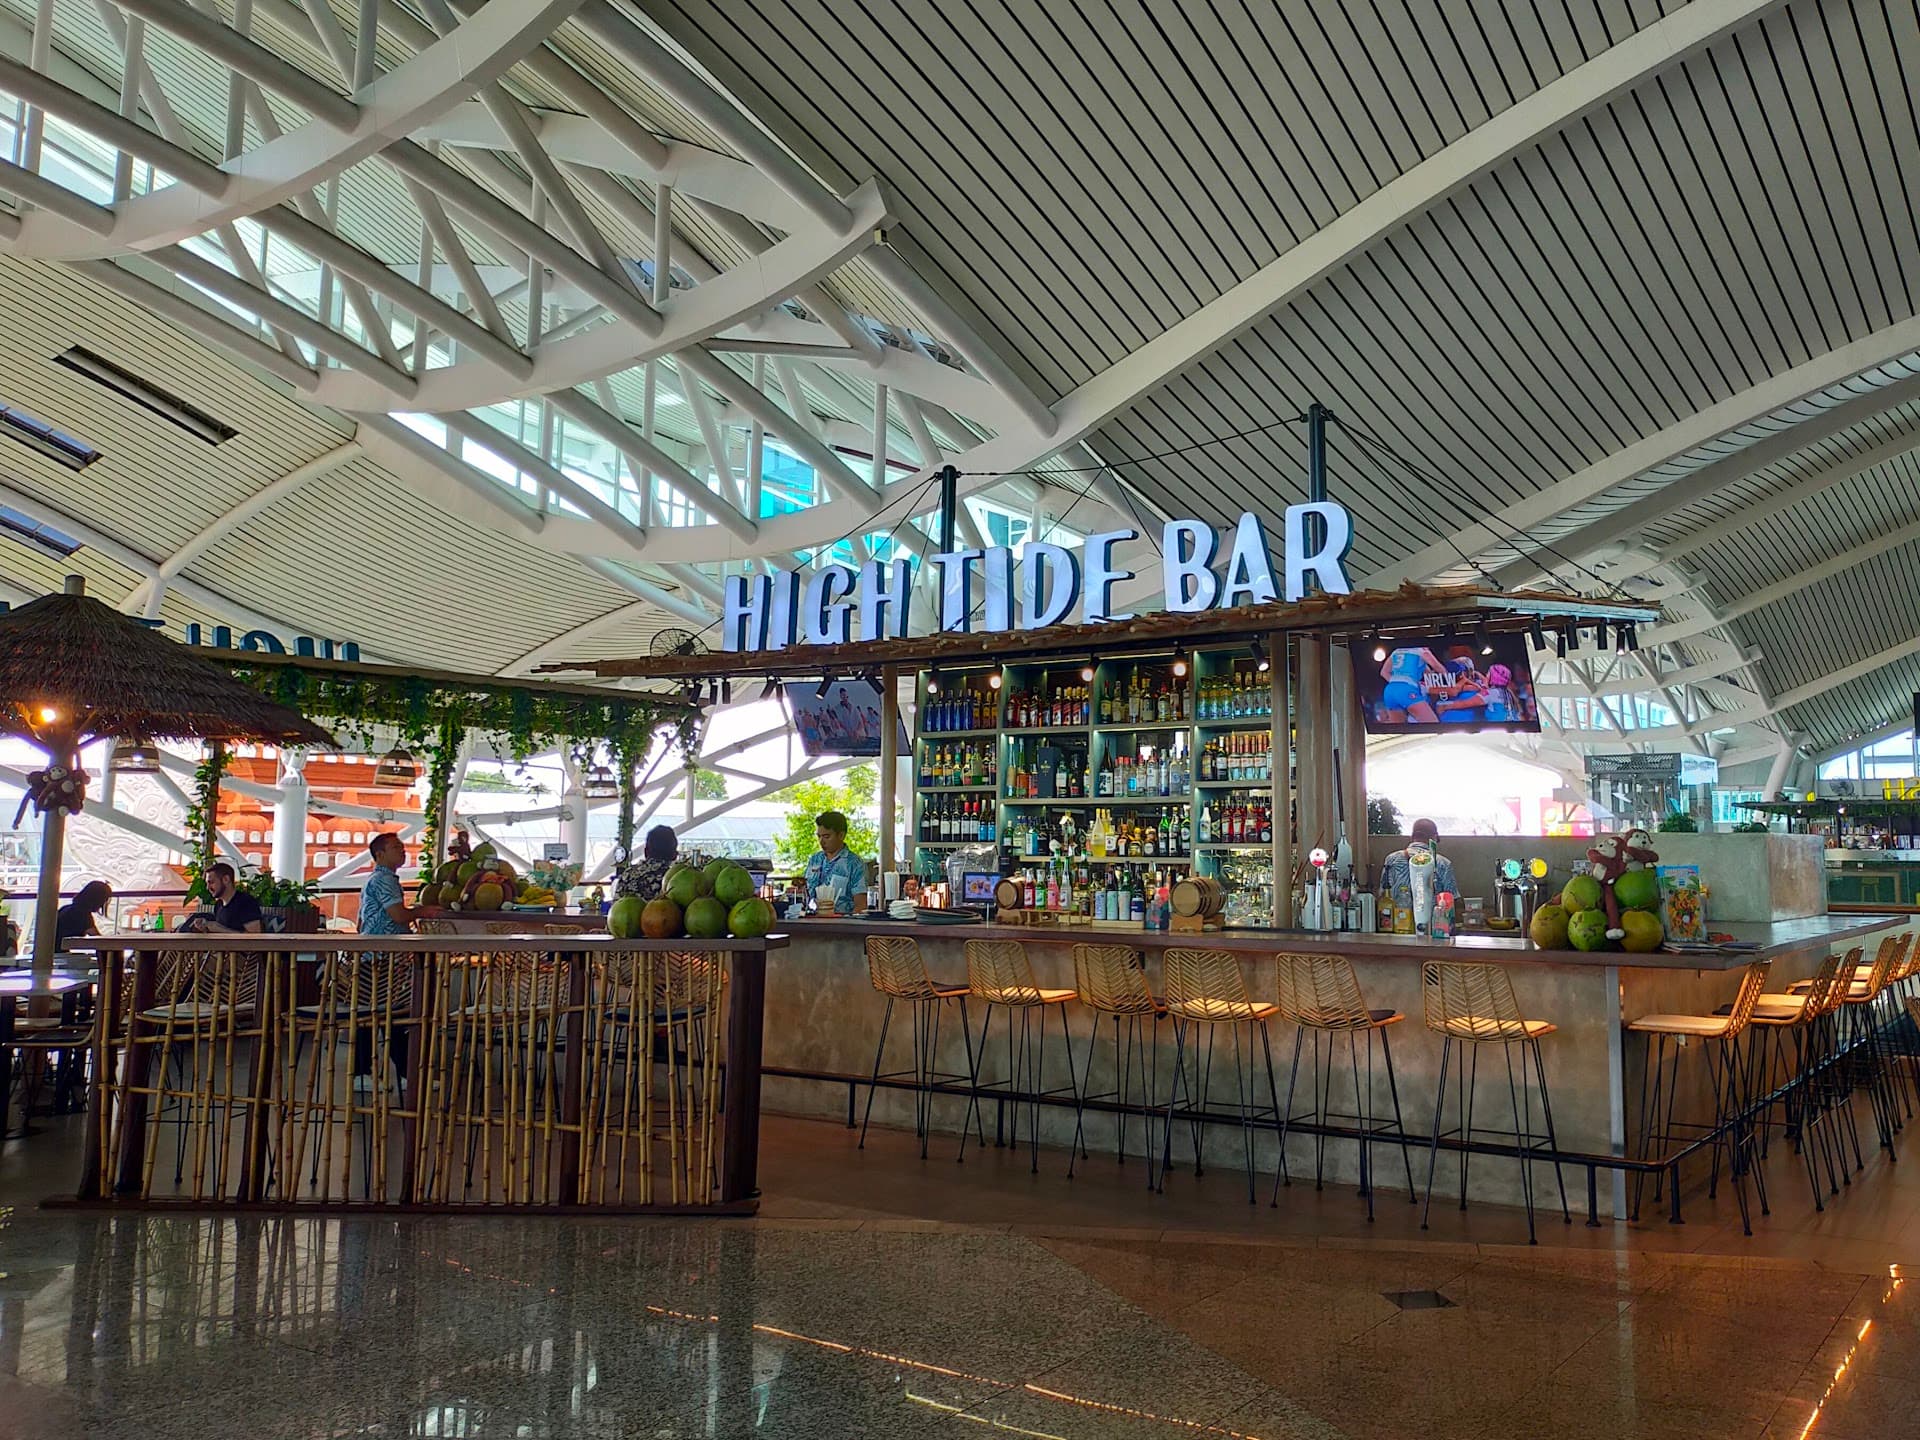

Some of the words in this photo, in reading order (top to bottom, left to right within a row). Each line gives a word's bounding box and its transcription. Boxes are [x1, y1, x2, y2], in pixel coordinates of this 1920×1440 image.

[723, 559, 911, 652] HIGH
[929, 529, 1140, 633] TIDE
[1163, 501, 1355, 613] BAR
[1424, 672, 1456, 688] NRLW
